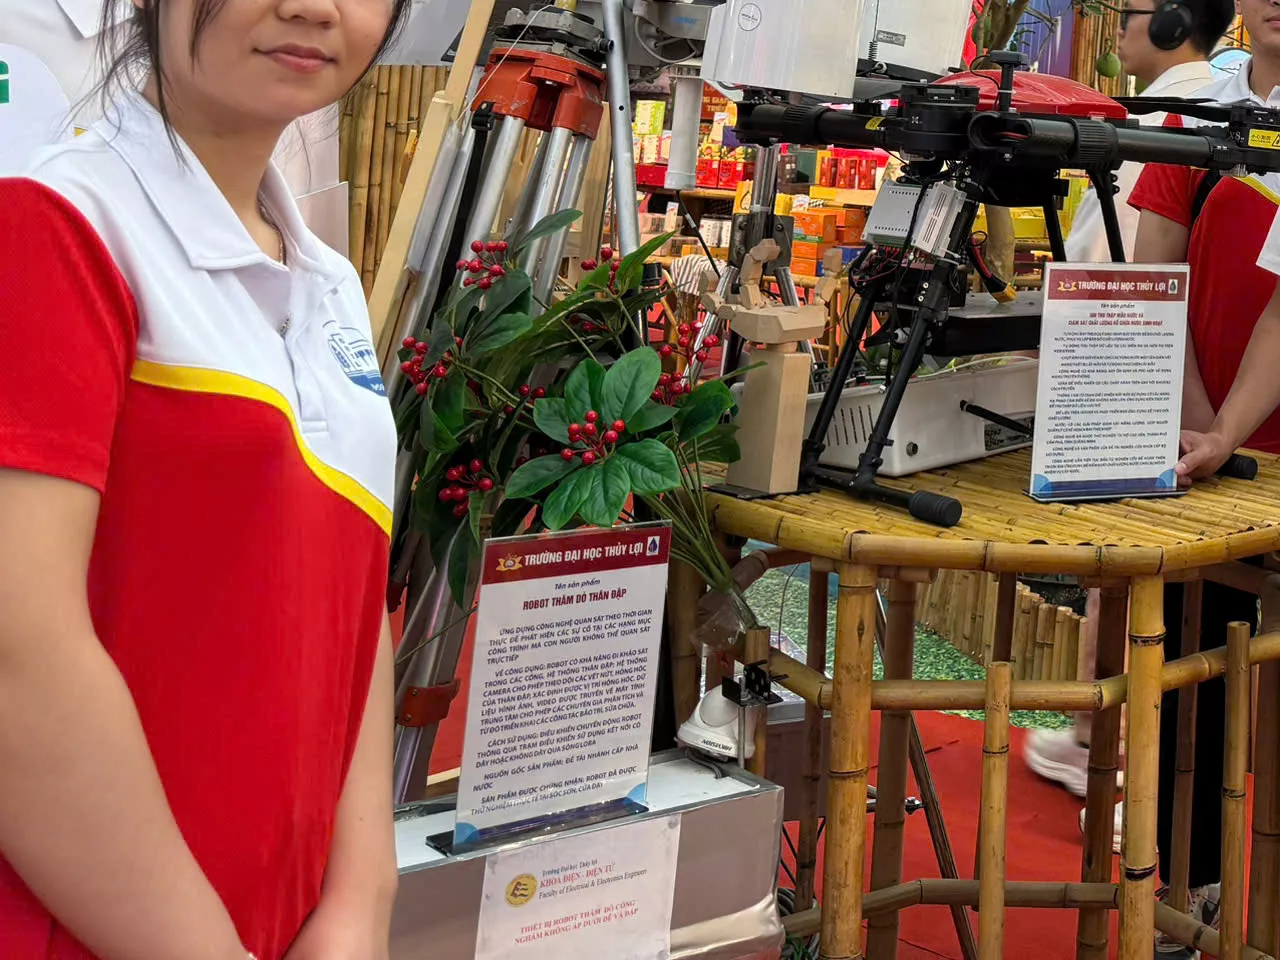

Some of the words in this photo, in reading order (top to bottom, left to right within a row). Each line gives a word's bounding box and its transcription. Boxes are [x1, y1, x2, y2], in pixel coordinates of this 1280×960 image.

[1077, 280, 1105, 289] TRƯỜNG
[1107, 282, 1119, 291] ĐẠI
[1120, 282, 1134, 291] HỌC
[1136, 279, 1153, 290] THỦY
[1154, 282, 1165, 292] LỢI
[523, 548, 562, 566] TRƯỜNG
[564, 549, 580, 563] ĐẠI
[582, 547, 602, 561] HỌC
[604, 541, 627, 557] THỦY
[628, 542, 643, 556] LỢI
[522, 598, 549, 610] ROBOT
[610, 586, 626, 600] ĐẬP
